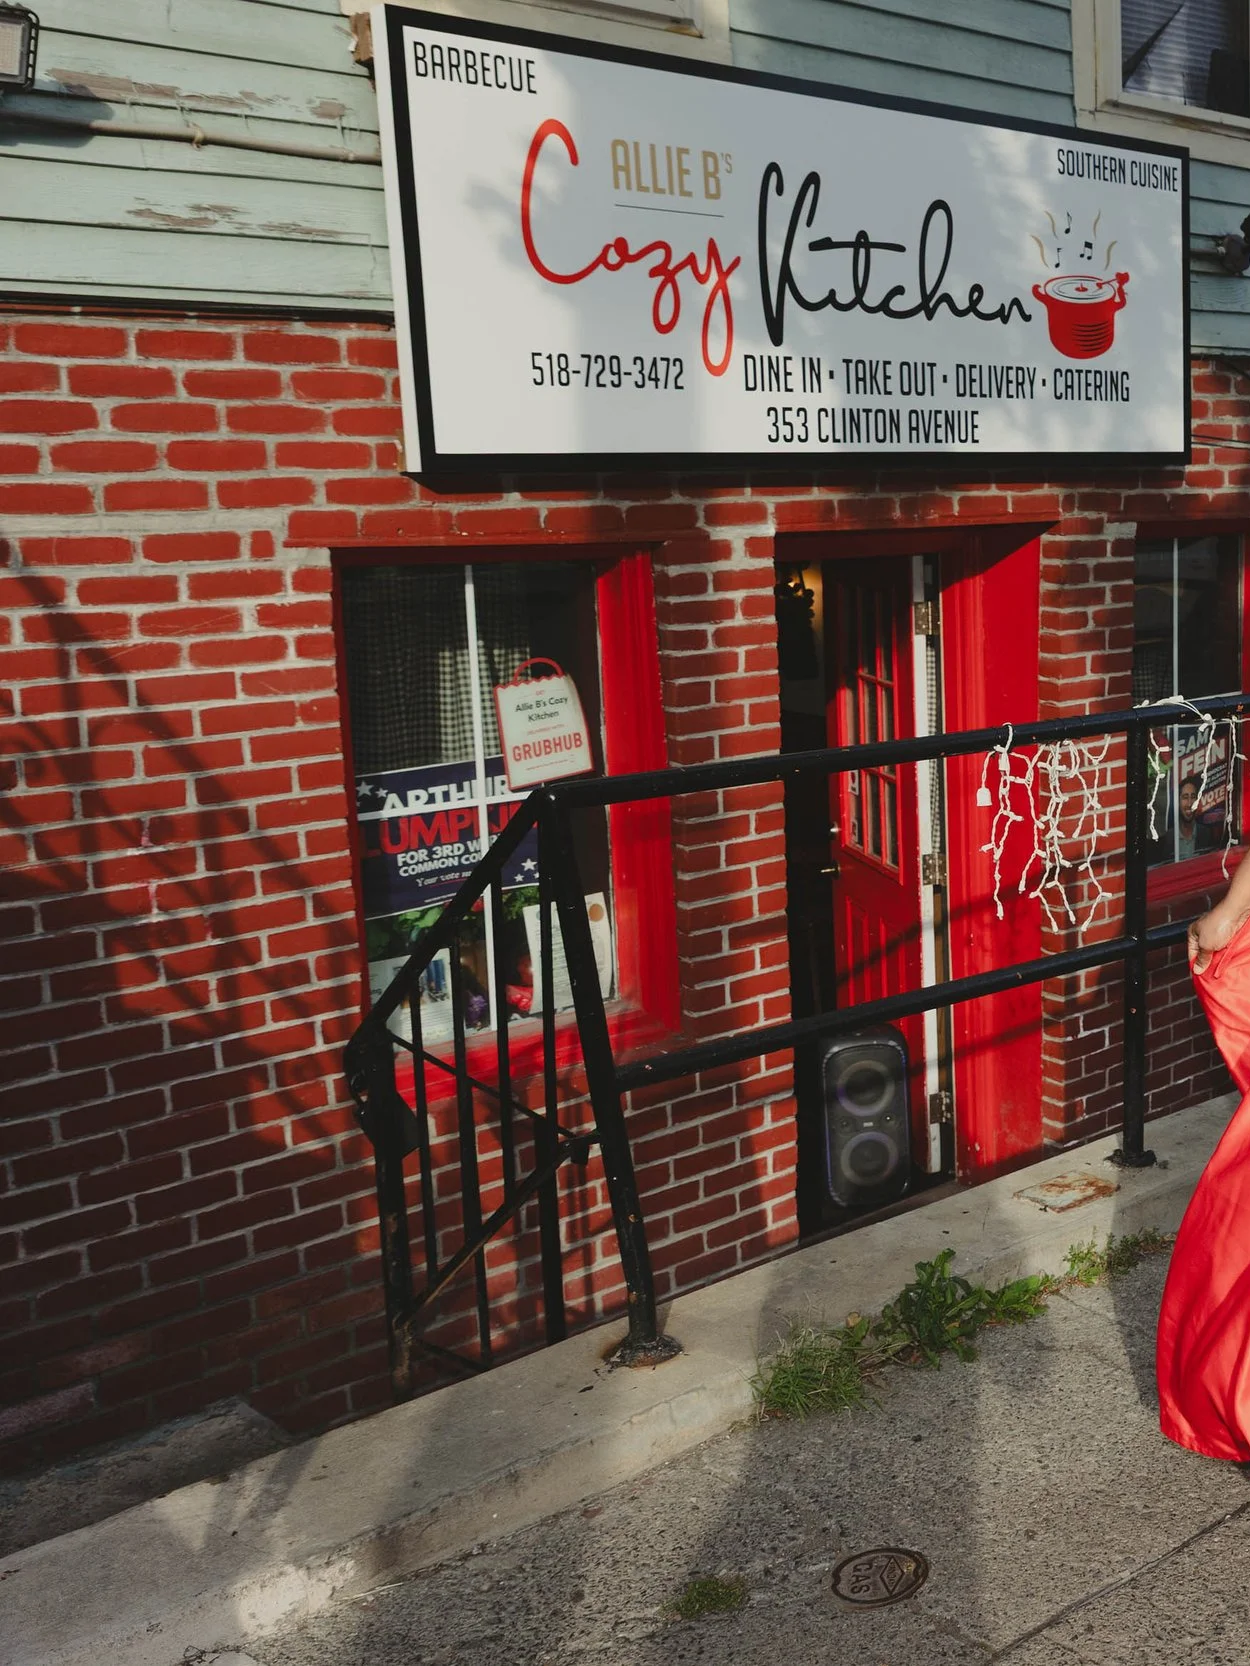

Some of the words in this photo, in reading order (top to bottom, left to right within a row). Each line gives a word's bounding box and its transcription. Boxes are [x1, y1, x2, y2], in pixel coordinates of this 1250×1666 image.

[413, 40, 537, 95] BARBECUE
[610, 138, 693, 198] ALLIE
[1056, 147, 1126, 185] SOUTHERN
[1130, 159, 1178, 192] CUISINE
[521, 118, 742, 377] Cozy
[757, 161, 1033, 348] Kitchen
[530, 351, 685, 391] 518-729-3472
[743, 353, 794, 393] DINE
[800, 356, 822, 394] IN
[842, 357, 892, 396] TAKE
[899, 360, 937, 398] OUT
[955, 363, 1037, 400] DELIVERY
[1052, 367, 1131, 403] CATERING
[766, 405, 810, 444] 353
[817, 406, 901, 444] CLINTON
[908, 408, 980, 444] AVENUE
[515, 702, 533, 712] Allie
[548, 697, 568, 705] Cozy
[528, 711, 560, 722] Kitchen
[512, 732, 584, 762] GRUBHUB
[1178, 727, 1209, 758] SAM
[382, 774, 508, 811] ARTHUR
[1201, 784, 1226, 806] VOTE
[397, 849, 430, 867] FOR
[432, 843, 466, 859] 3RD
[399, 856, 459, 877] COMMON
[416, 876, 439, 887] Your
[440, 872, 460, 881] vote
[850, 1562, 873, 1595] GAS
